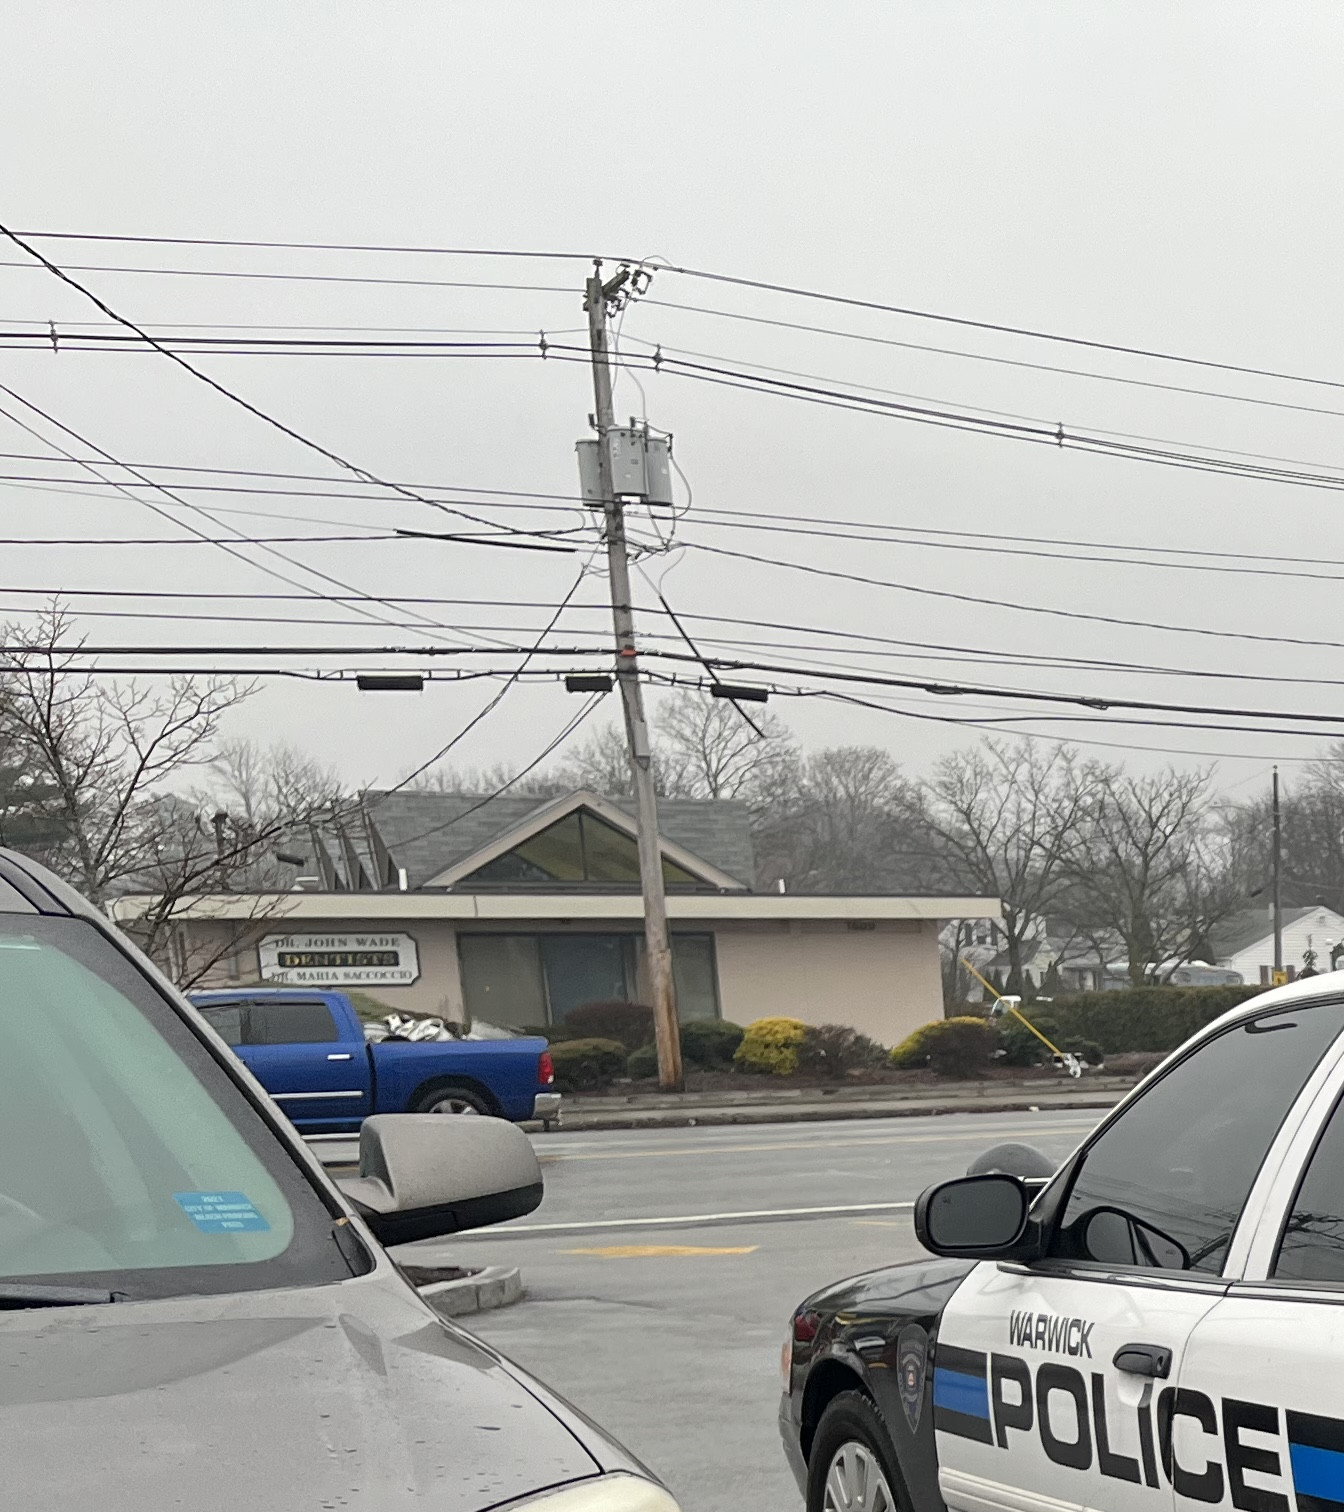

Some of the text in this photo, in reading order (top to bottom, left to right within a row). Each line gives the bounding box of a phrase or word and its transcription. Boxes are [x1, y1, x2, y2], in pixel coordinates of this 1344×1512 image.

[305, 938, 348, 948] JOHN
[355, 937, 400, 947] WADE
[284, 952, 396, 967] DENTISTS
[296, 971, 339, 981] MARIA
[343, 970, 413, 980] SACCOCCIO
[1010, 1309, 1095, 1358] WARWICK
